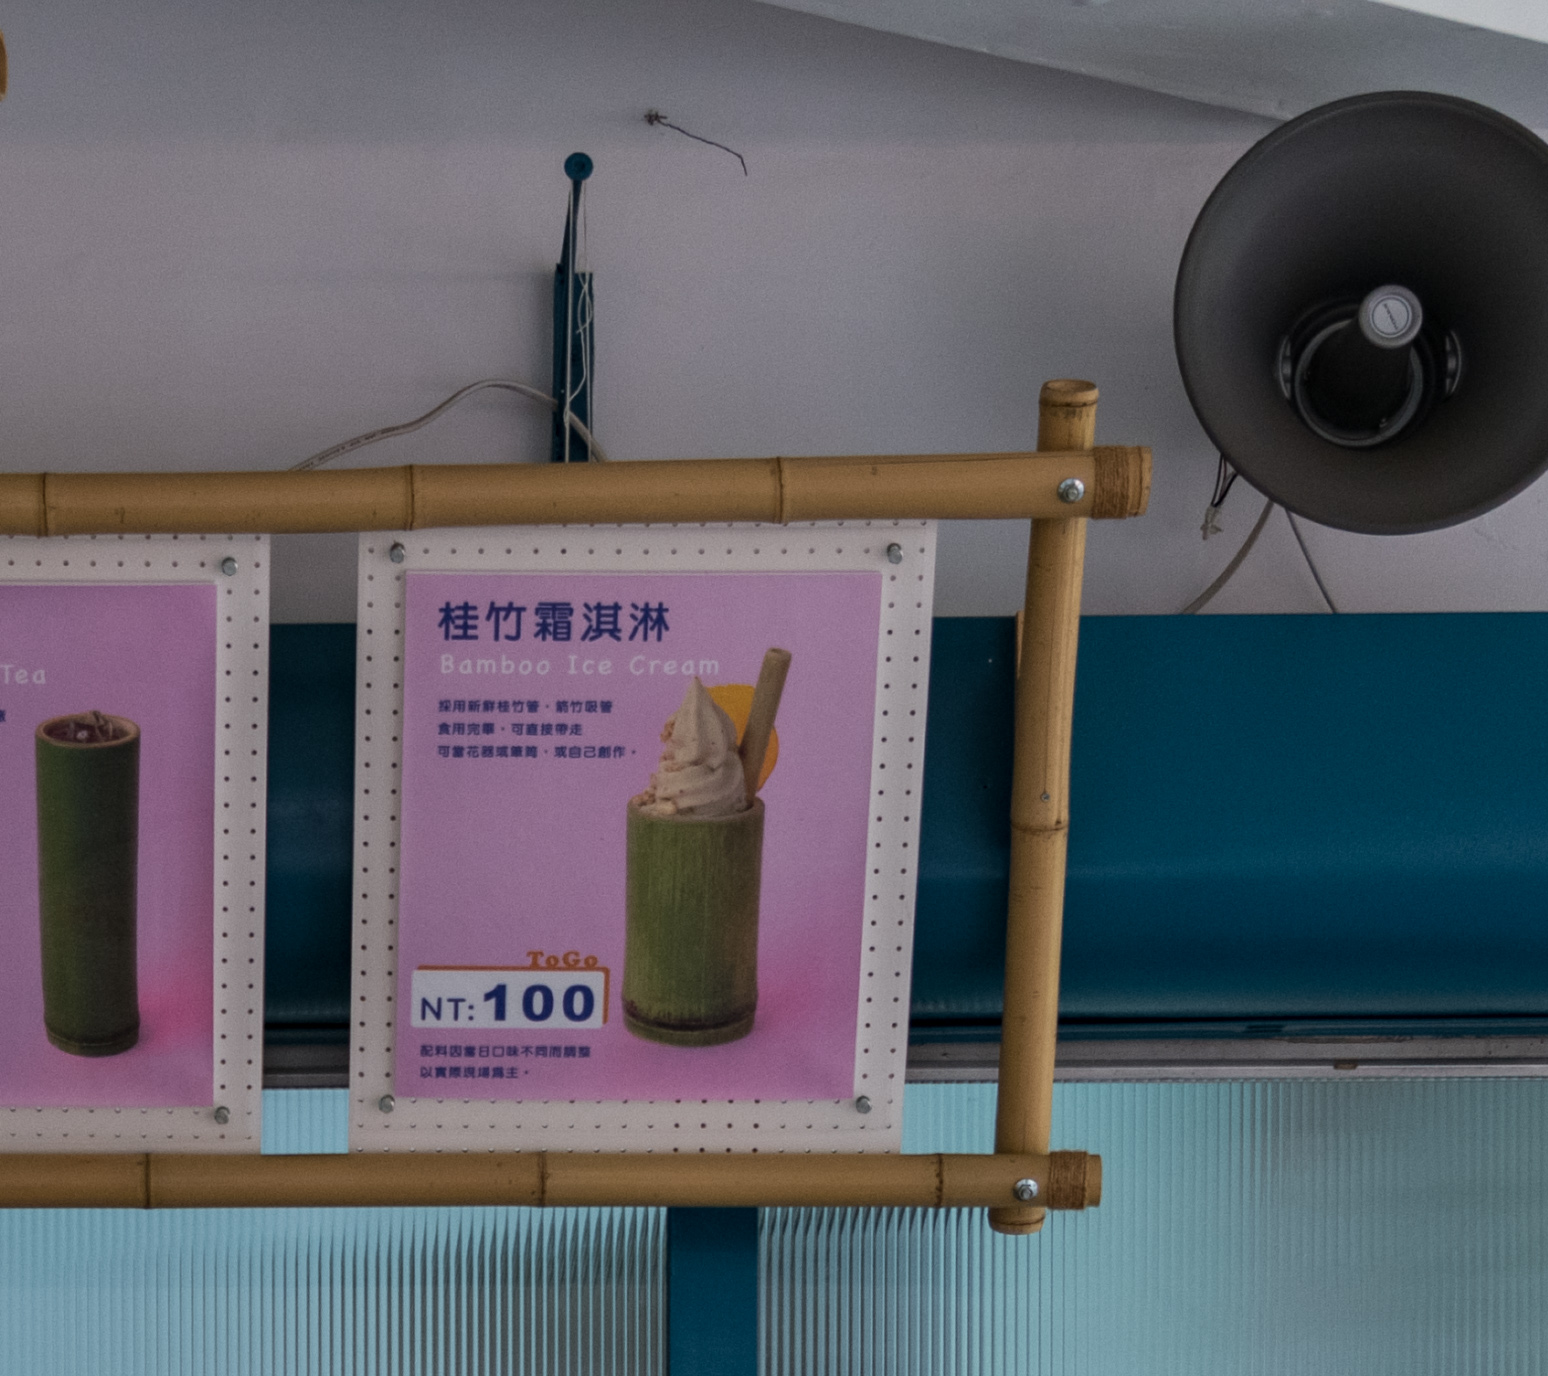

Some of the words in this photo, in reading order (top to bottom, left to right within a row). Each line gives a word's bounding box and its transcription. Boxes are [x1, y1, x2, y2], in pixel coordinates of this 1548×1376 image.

[437, 601, 671, 642] 桂竹霜淇淋
[0, 664, 47, 685] Tea
[440, 654, 551, 675] Bamboo
[568, 654, 613, 675] Ice
[629, 655, 720, 676] Cream
